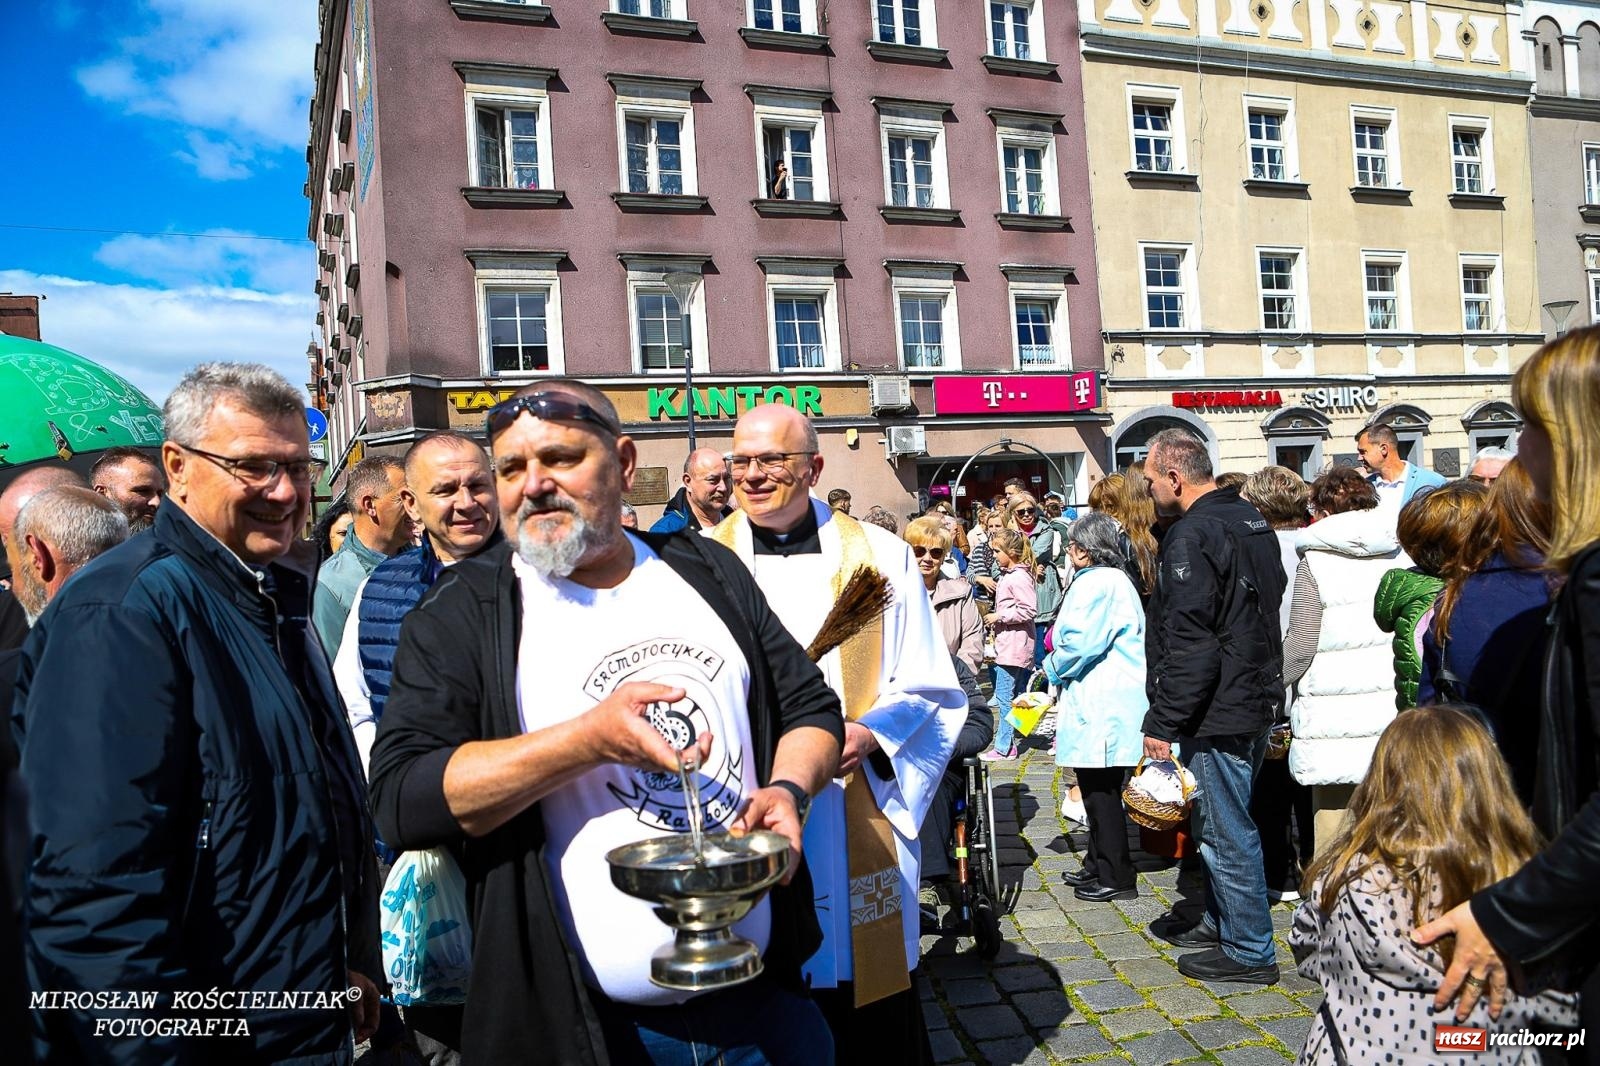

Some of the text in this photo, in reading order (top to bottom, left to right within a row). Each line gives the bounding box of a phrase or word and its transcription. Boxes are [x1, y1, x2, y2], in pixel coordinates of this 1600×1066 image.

[647, 385, 823, 417] KANTOR
[1172, 390, 1283, 408] RESTAURACJA
[1314, 385, 1379, 408] SHIRO
